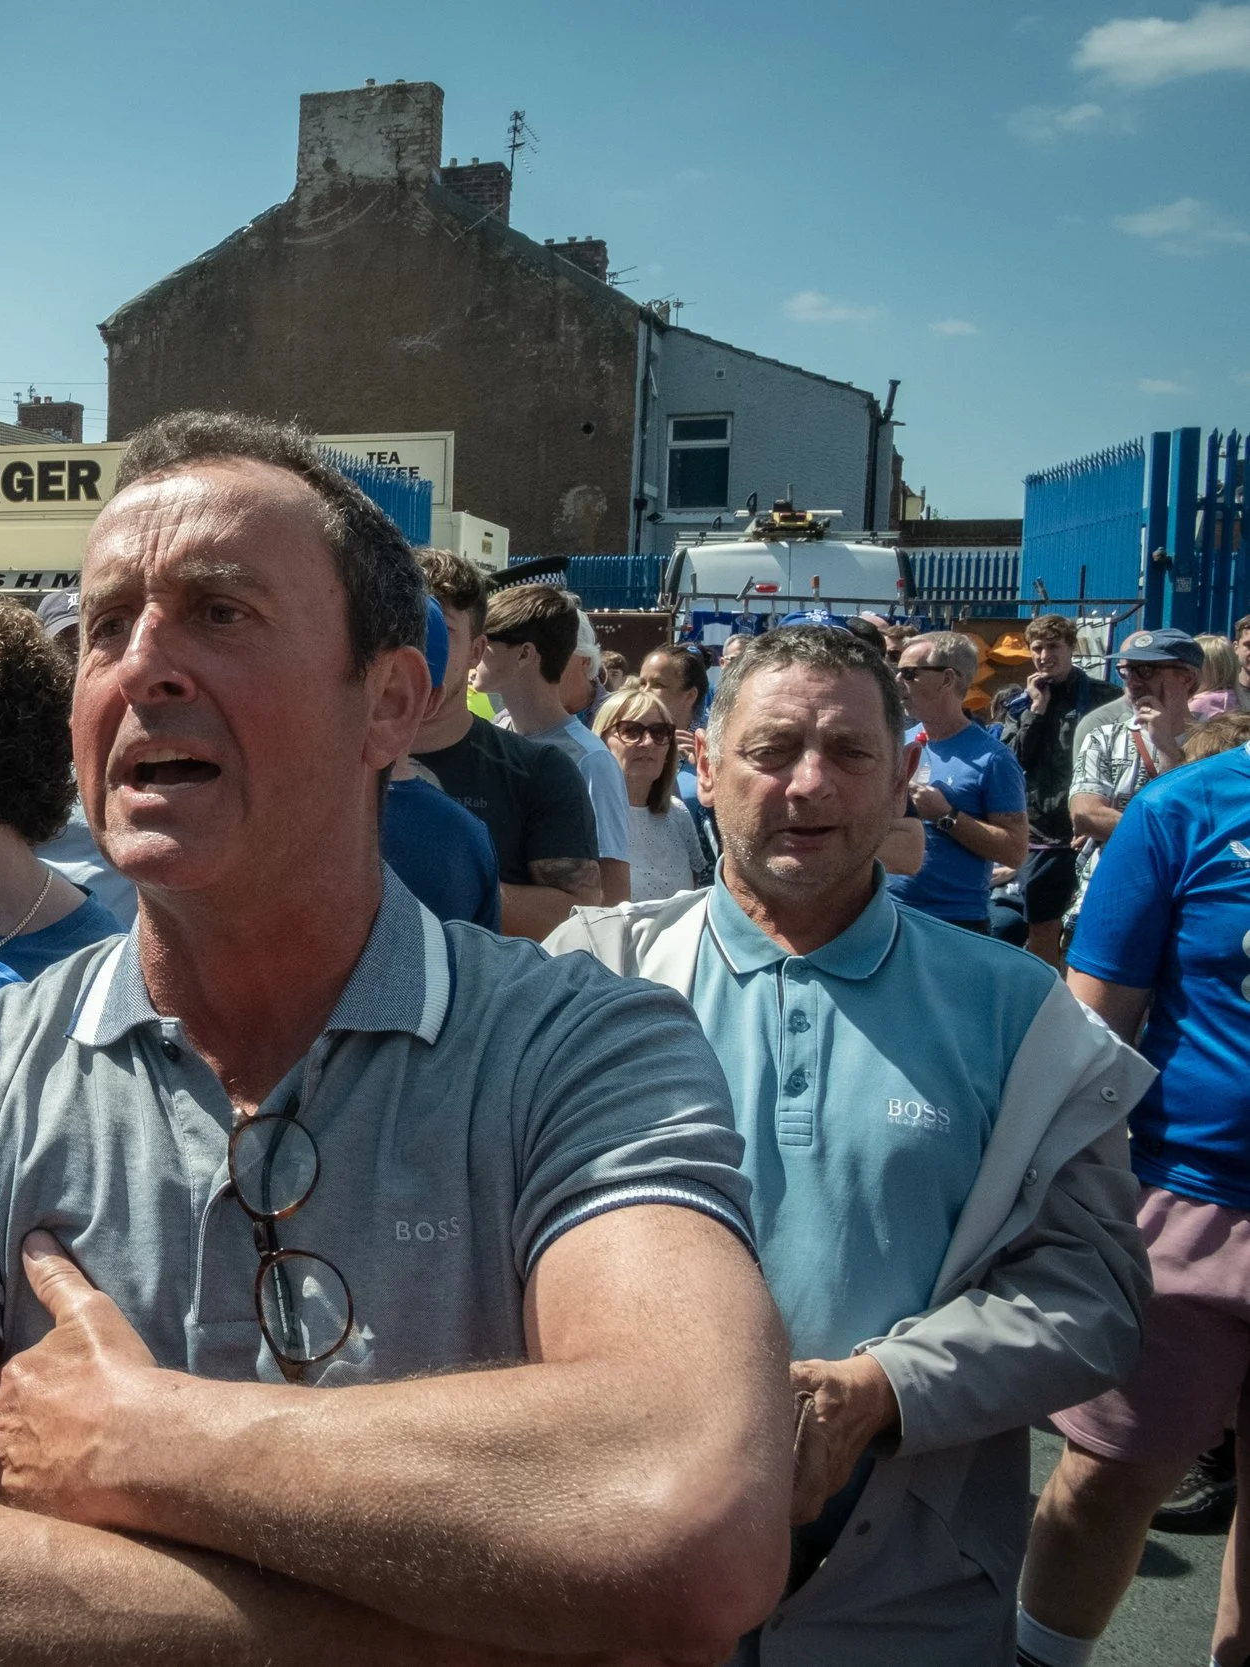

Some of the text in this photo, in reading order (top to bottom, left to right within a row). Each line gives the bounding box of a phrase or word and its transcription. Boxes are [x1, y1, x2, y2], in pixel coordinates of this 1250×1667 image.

[367, 452, 400, 464] TEA
[463, 796, 488, 809] Rab
[887, 1098, 950, 1125] BOSS
[395, 1216, 460, 1242] BOSS
